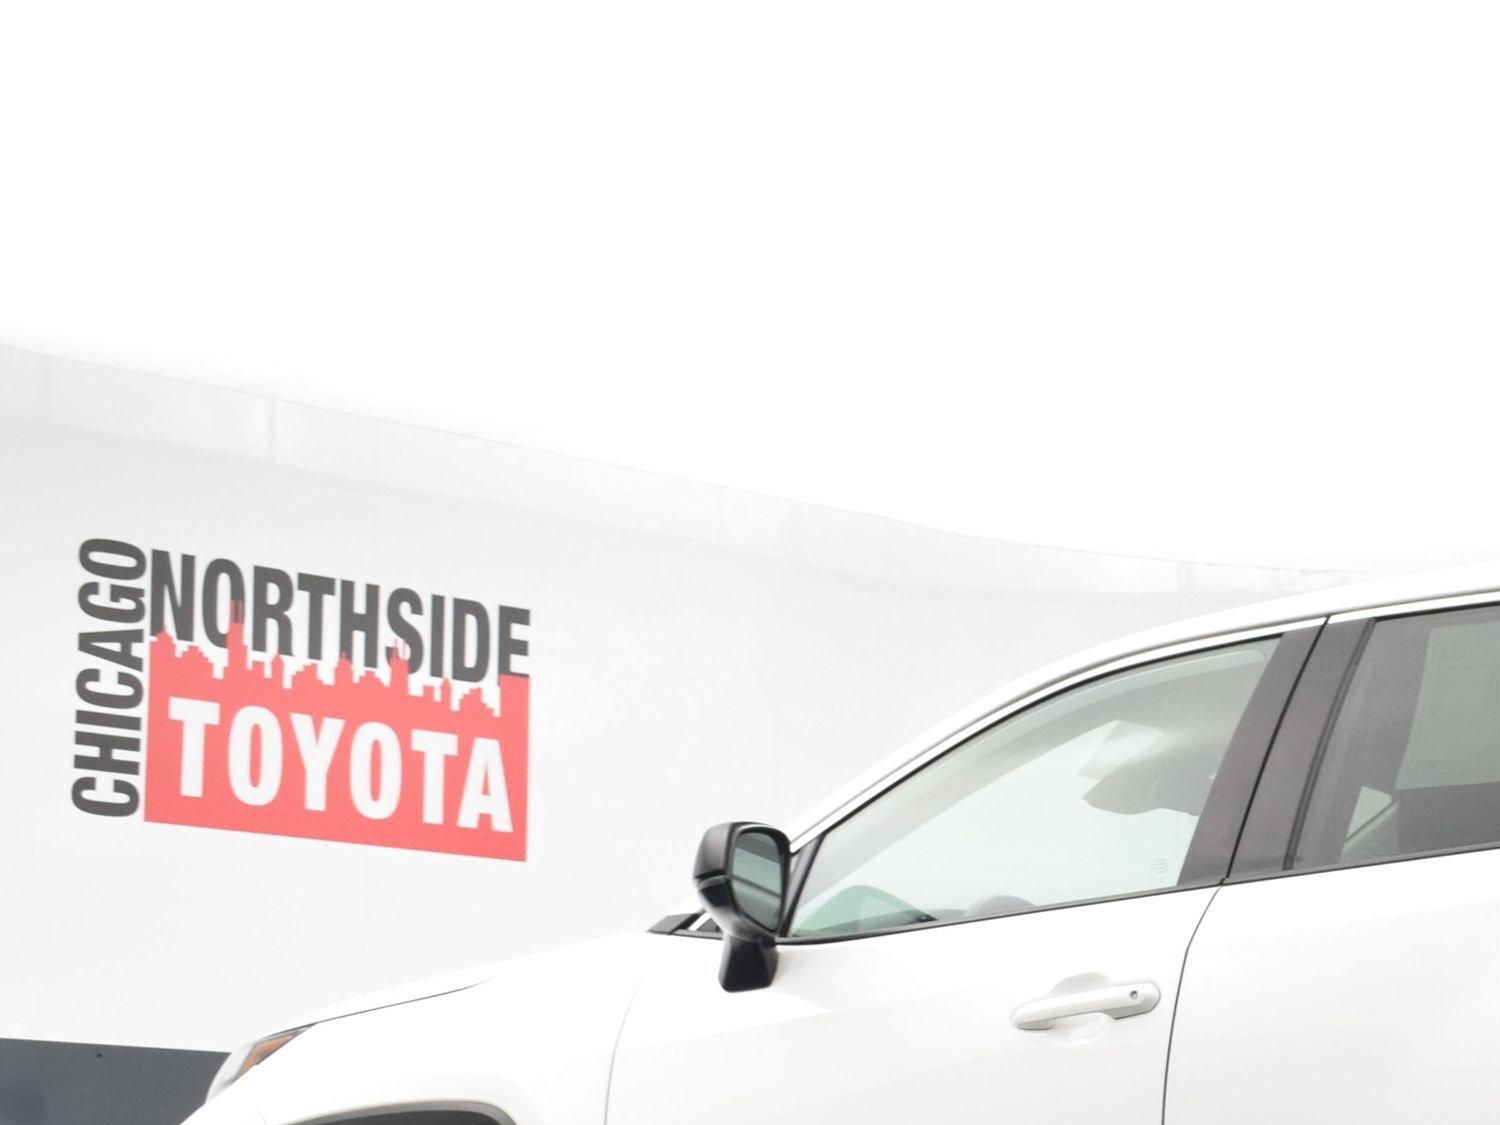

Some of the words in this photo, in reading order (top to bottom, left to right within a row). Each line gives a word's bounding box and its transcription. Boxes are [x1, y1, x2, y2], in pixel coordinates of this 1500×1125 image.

[72, 538, 147, 817] CHICAGO
[150, 548, 530, 682] NORTHSIDE
[168, 696, 514, 833] TOYOTA
